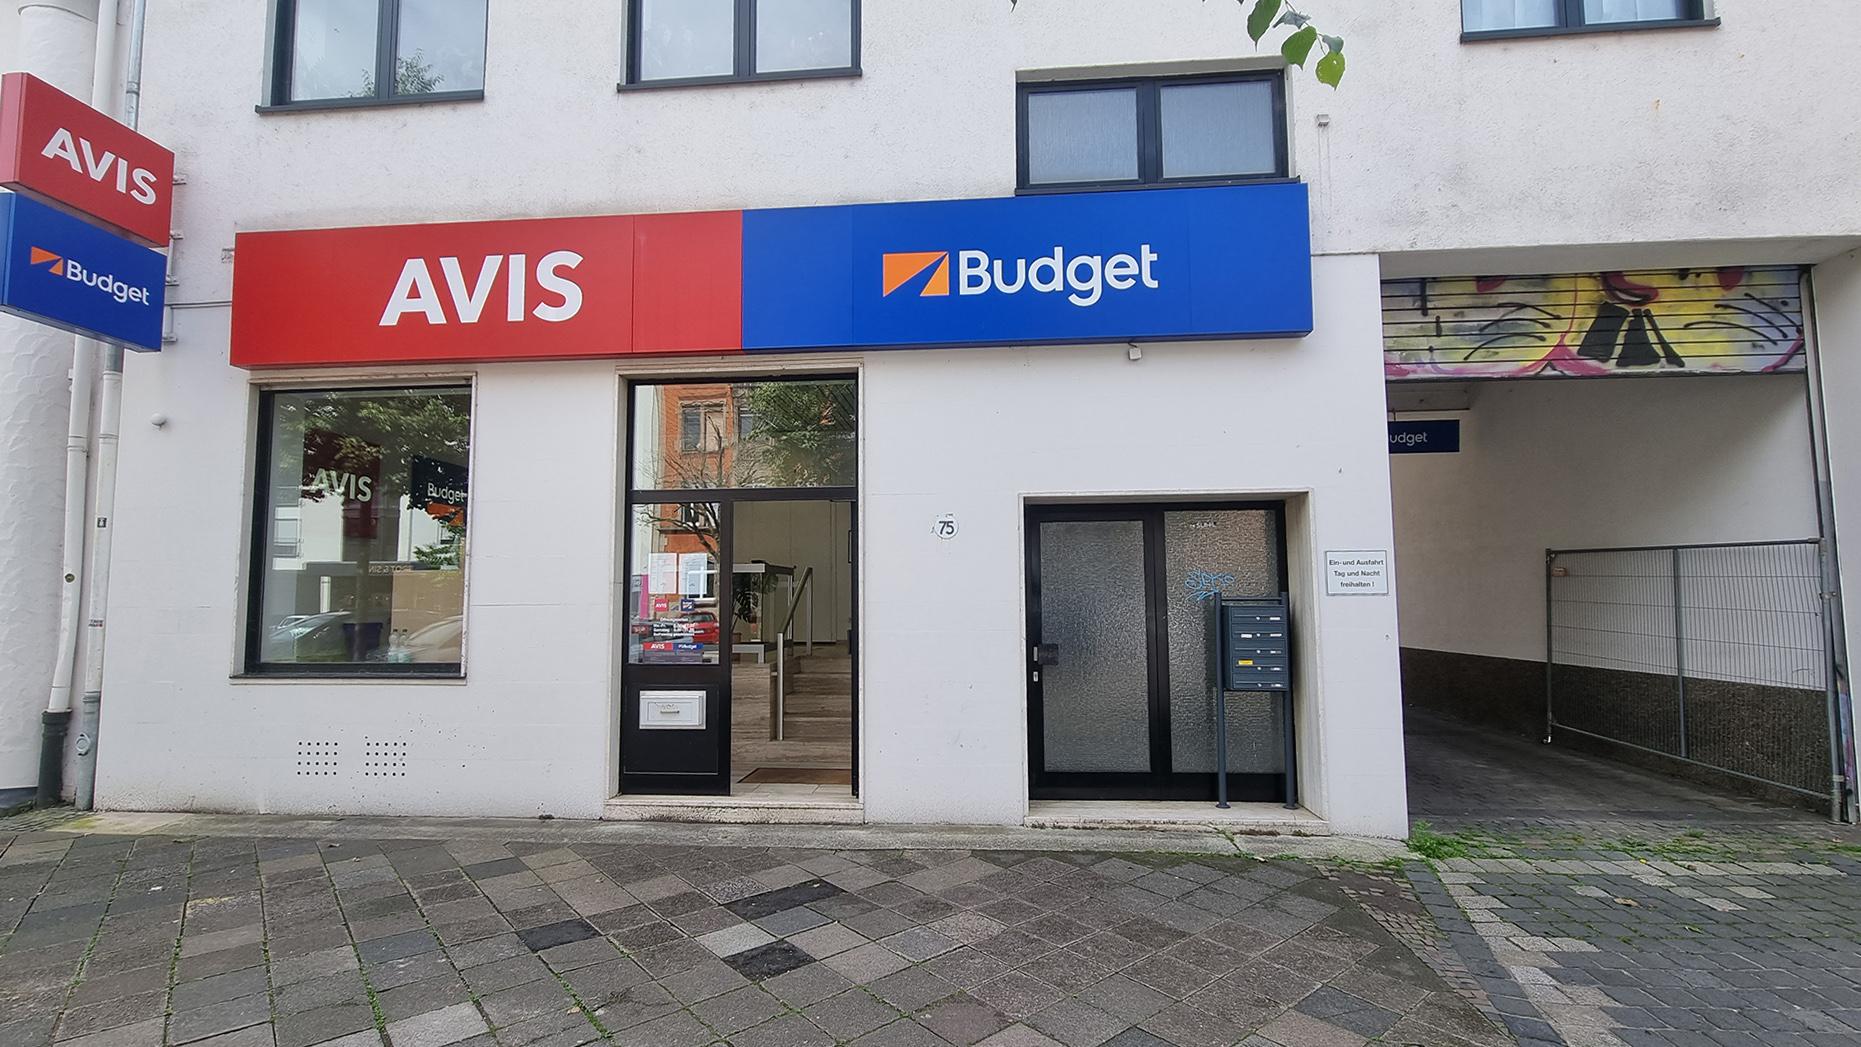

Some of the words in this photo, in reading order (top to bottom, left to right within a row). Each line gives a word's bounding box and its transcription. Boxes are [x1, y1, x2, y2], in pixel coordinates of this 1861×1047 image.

[41, 127, 157, 205] AVIS
[66, 259, 149, 305] Budget
[379, 250, 584, 326] AVIS
[959, 244, 1158, 307] Budget
[1389, 432, 1428, 446] udget
[311, 468, 372, 502] AVIS
[427, 482, 466, 504] Budget
[939, 520, 955, 535] 75
